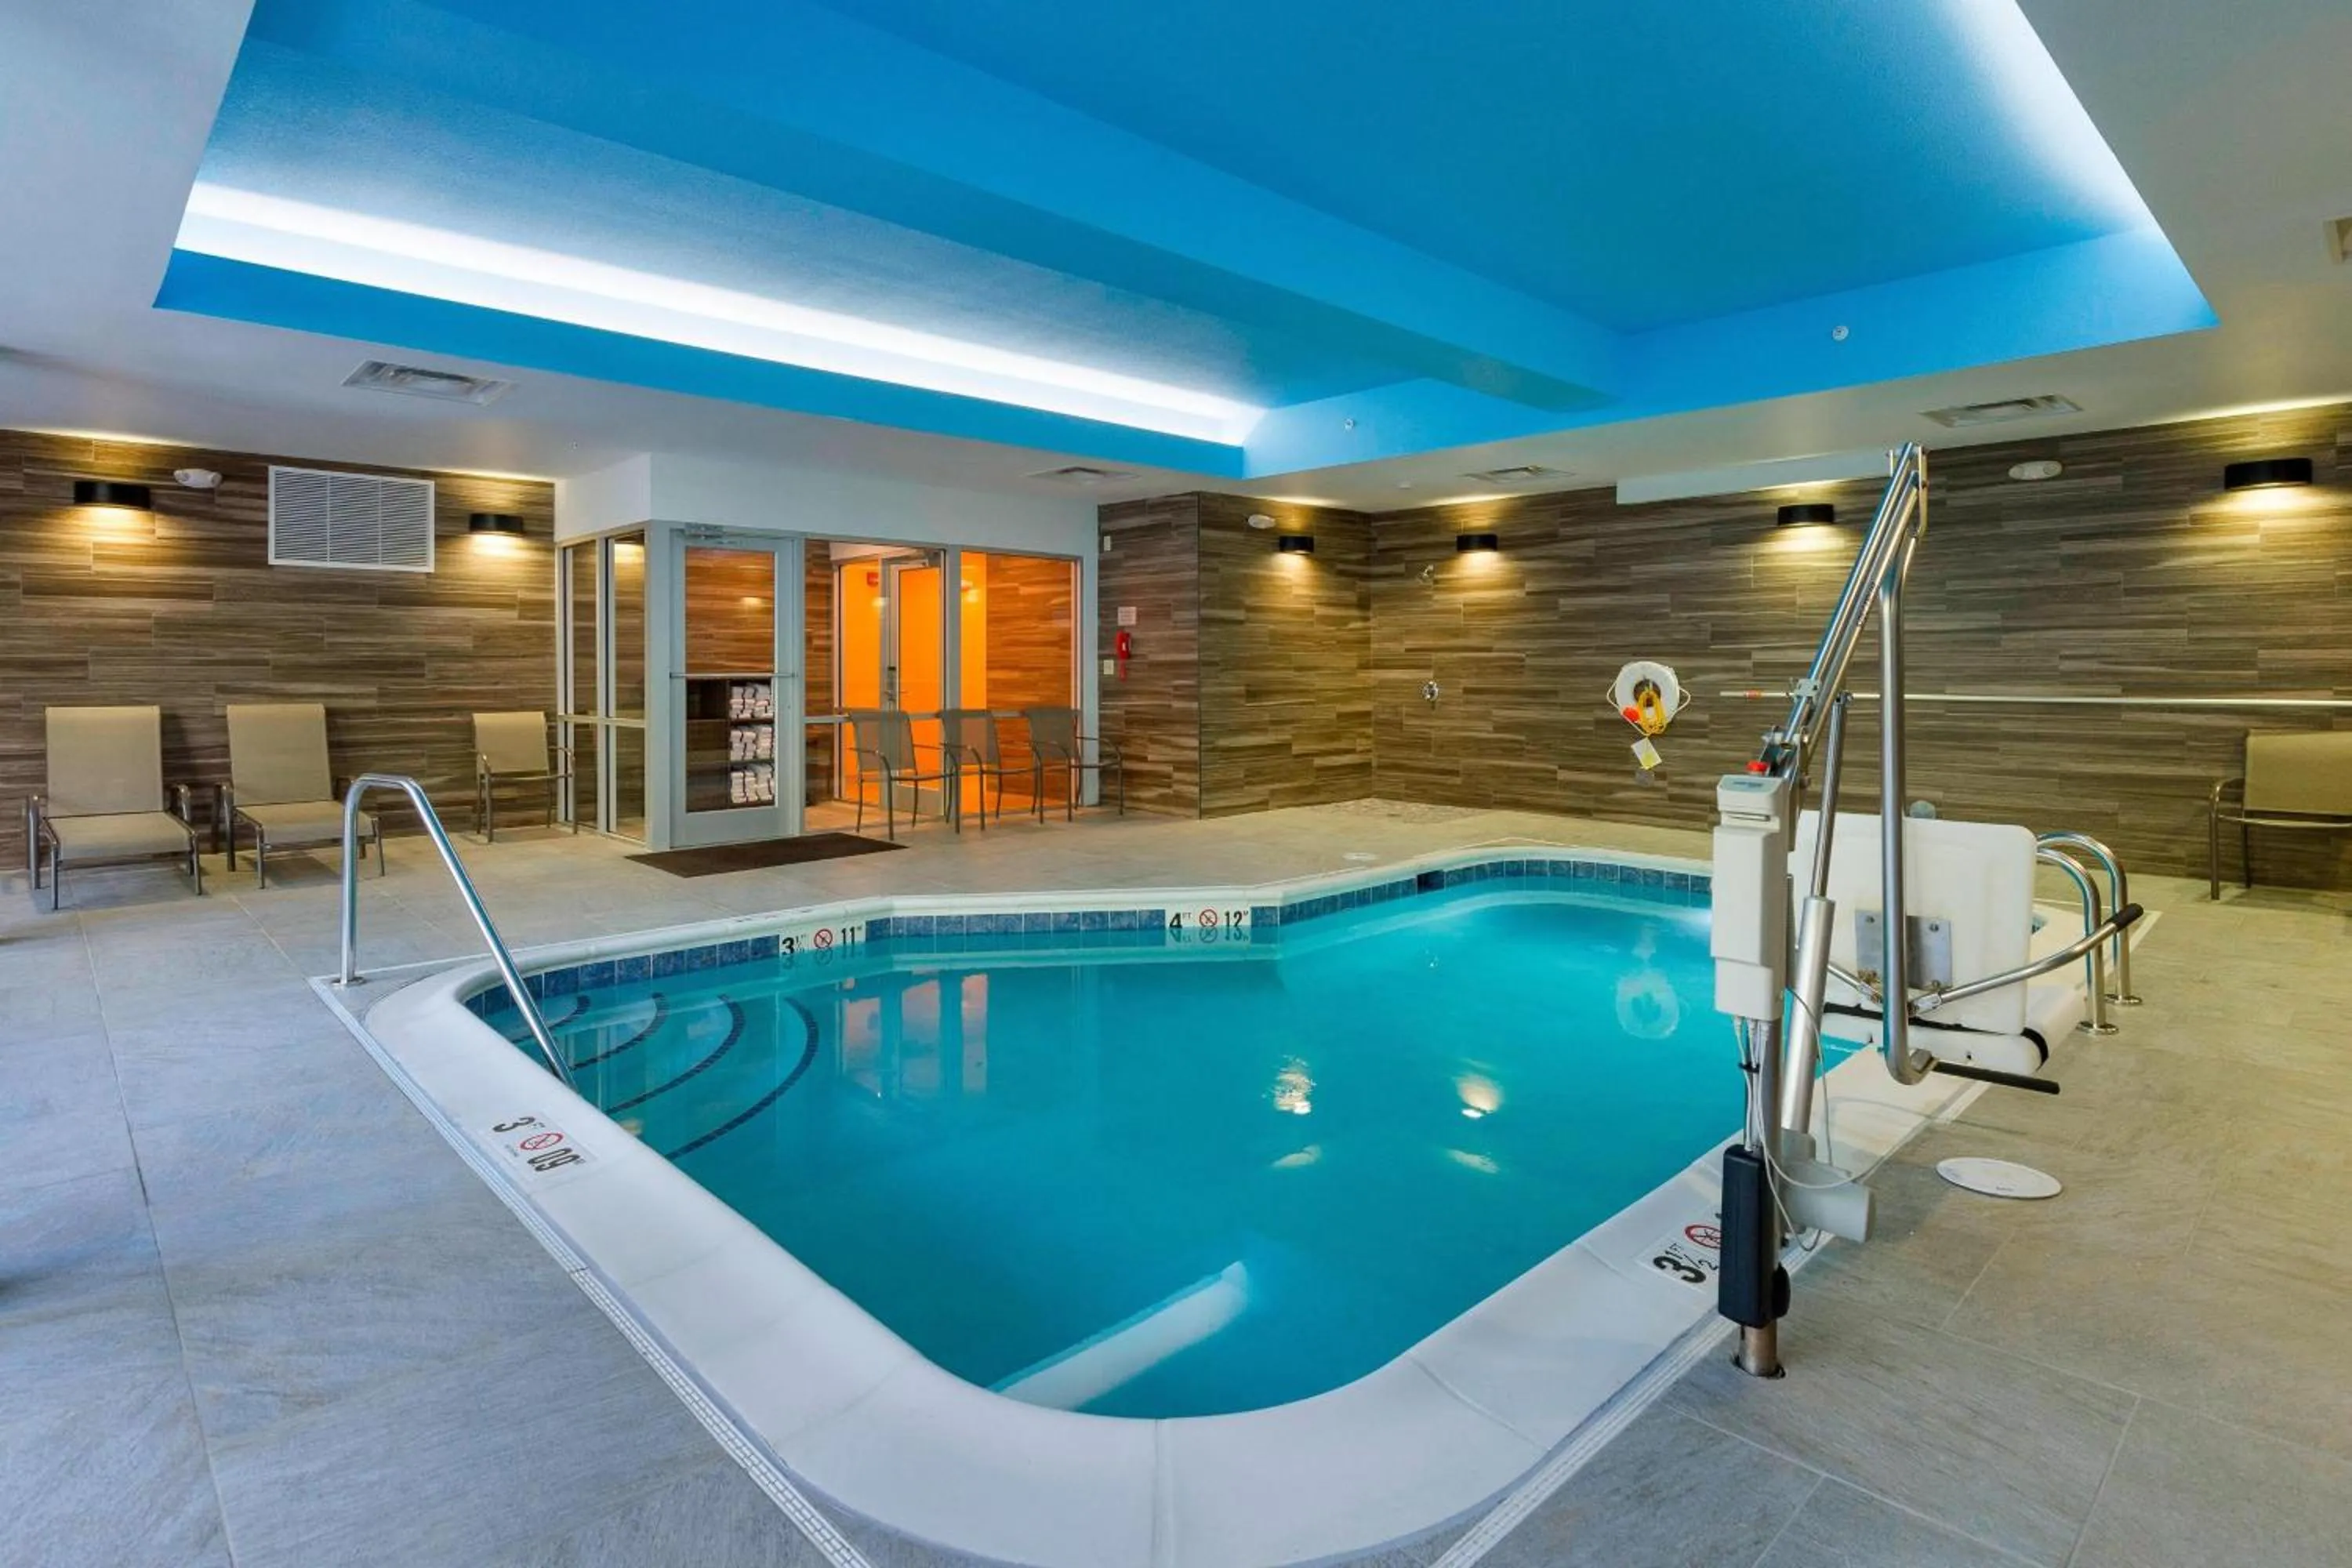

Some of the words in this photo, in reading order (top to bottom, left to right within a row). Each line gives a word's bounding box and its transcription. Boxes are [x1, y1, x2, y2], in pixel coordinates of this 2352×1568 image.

[1169, 912, 1182, 929] 4
[493, 1116, 535, 1132] 3
[1653, 1256, 1707, 1283] 3
